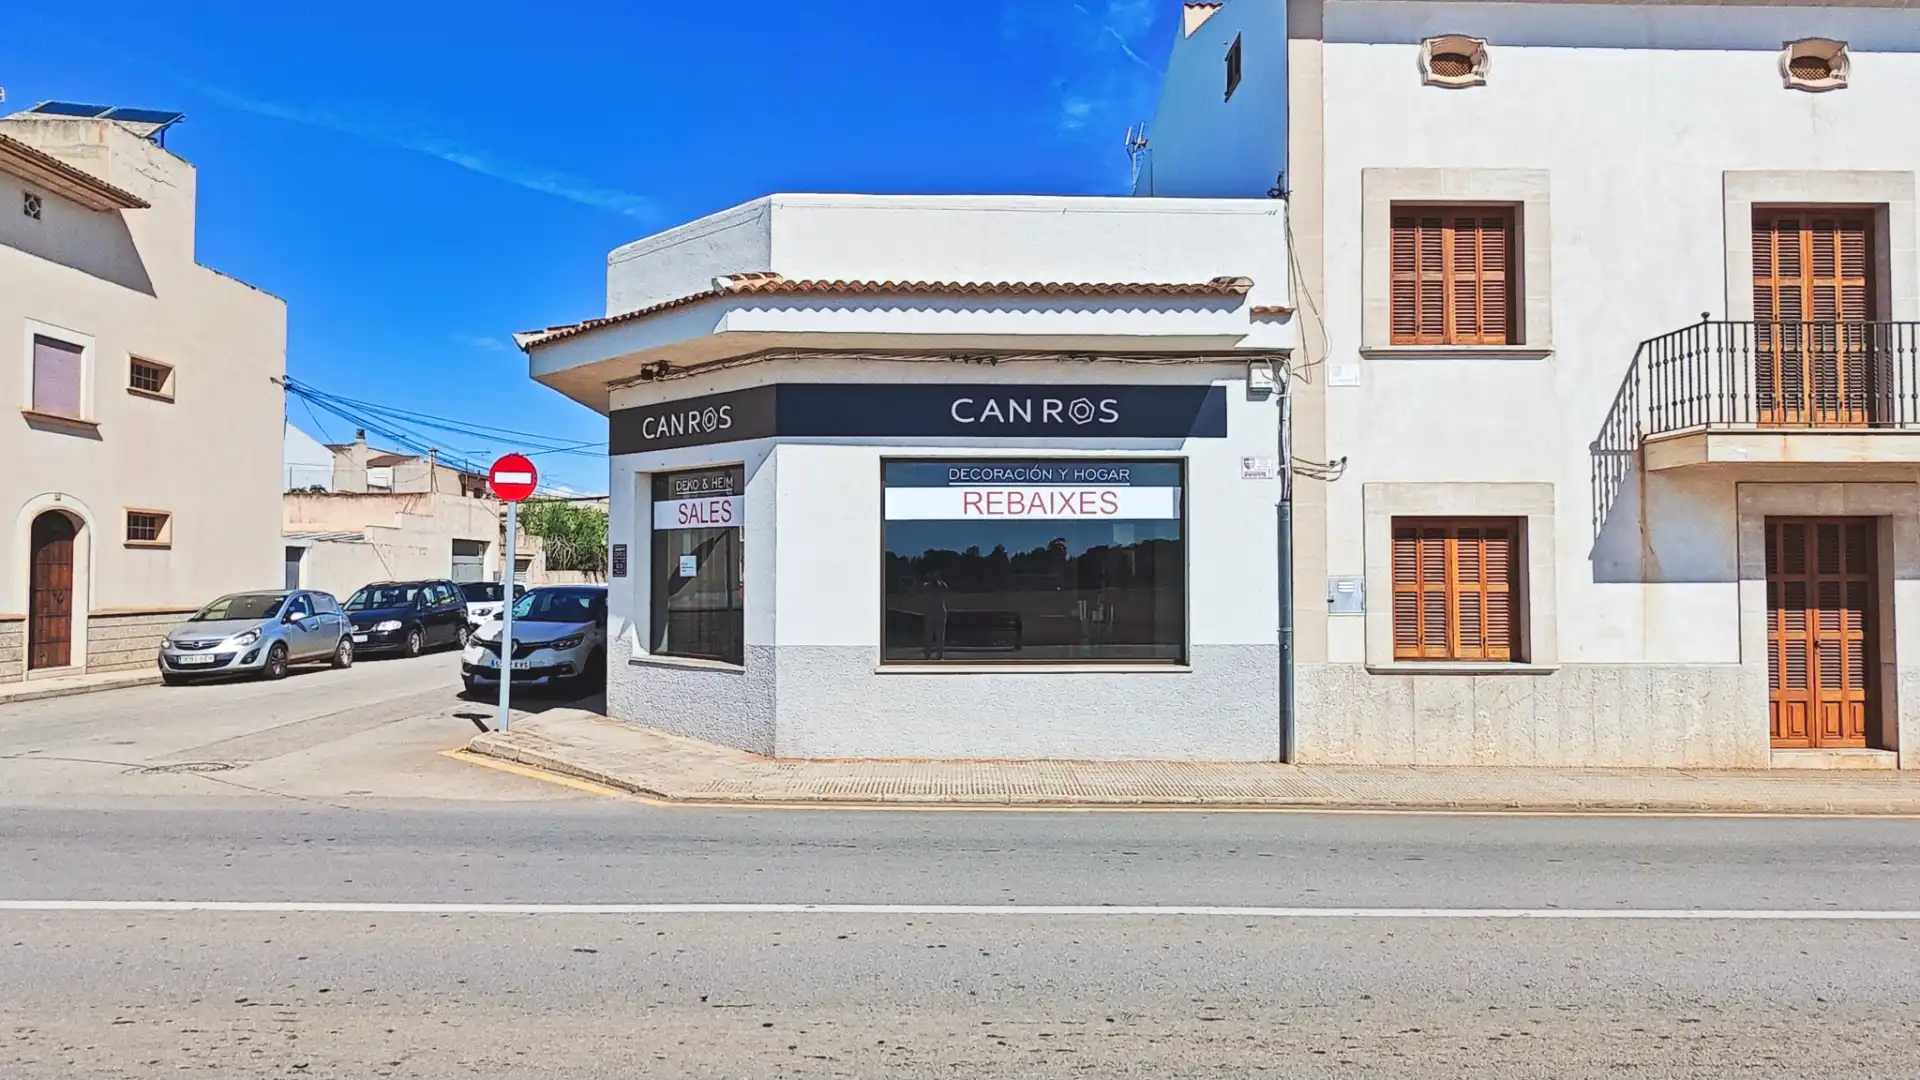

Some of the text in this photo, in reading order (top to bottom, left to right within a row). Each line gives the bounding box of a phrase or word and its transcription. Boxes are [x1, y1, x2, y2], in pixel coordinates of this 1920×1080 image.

[949, 464, 1130, 480] DECORACIÓN Y HOGAR
[676, 476, 733, 491] DEKO & HEIM
[678, 500, 732, 525] SALES
[964, 491, 1119, 515] REBAIXES
